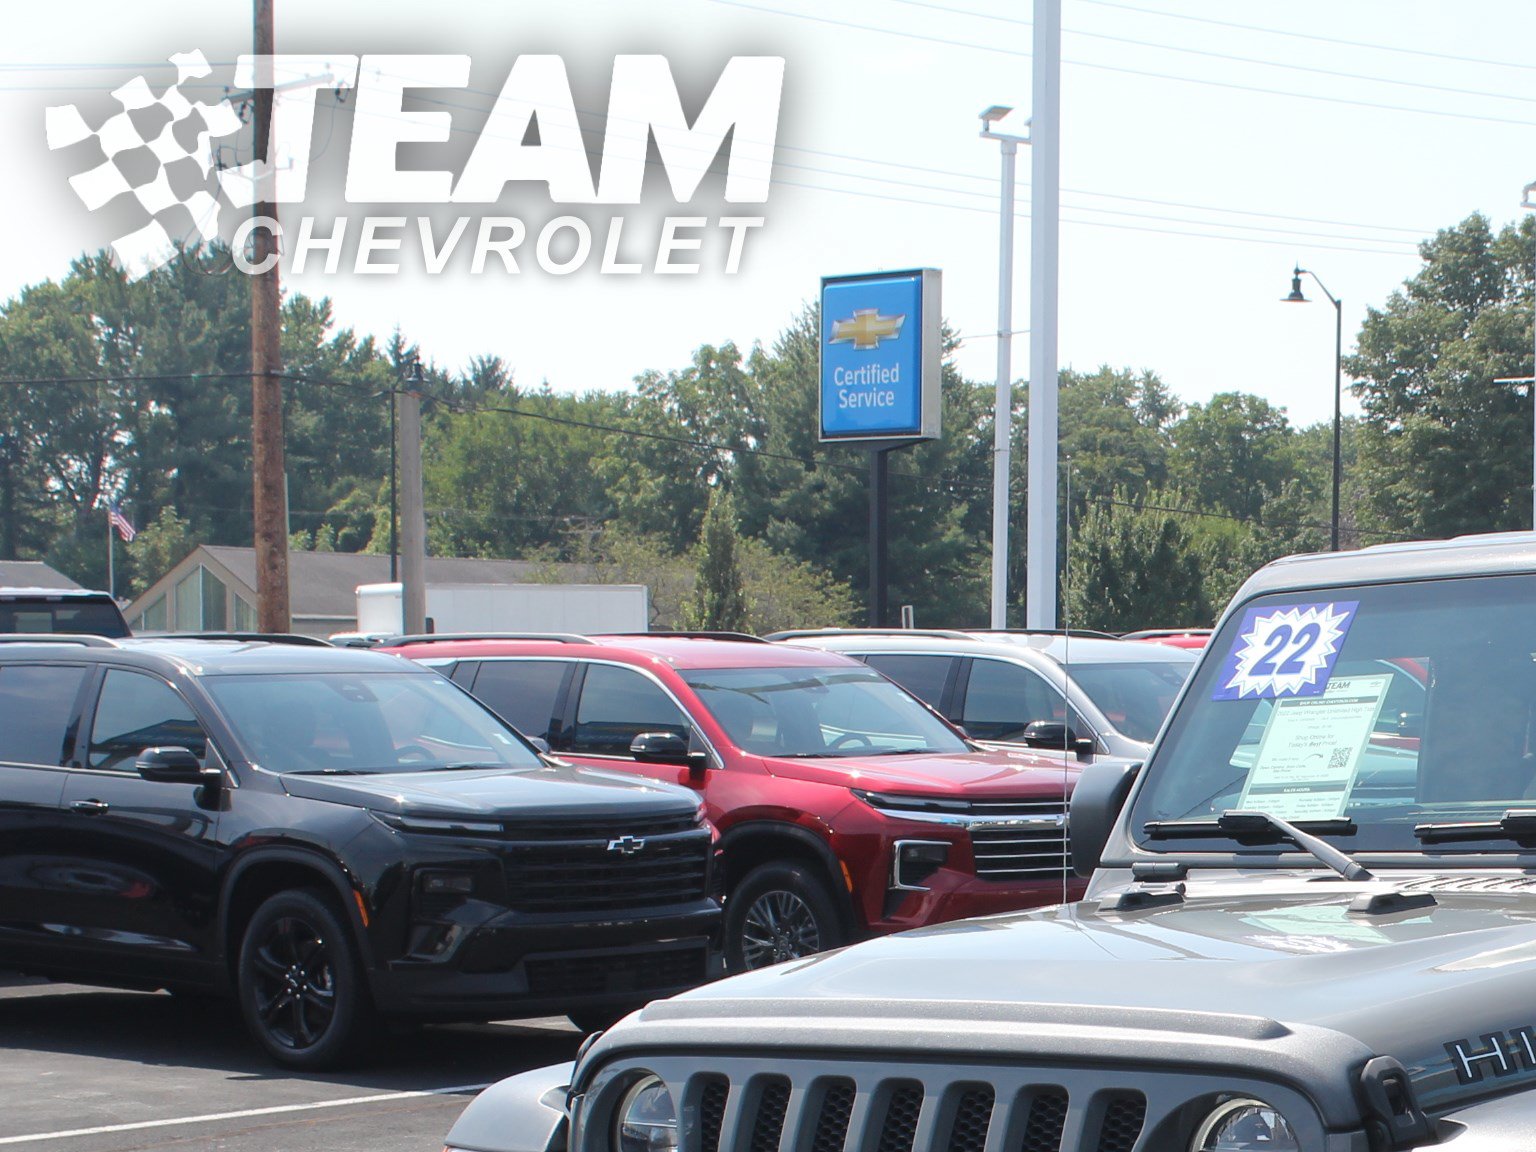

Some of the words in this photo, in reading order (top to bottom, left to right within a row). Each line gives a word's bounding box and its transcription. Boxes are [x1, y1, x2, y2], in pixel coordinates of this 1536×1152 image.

[834, 363, 900, 386] Certified
[839, 388, 895, 408] Service
[1247, 622, 1321, 676] 22
